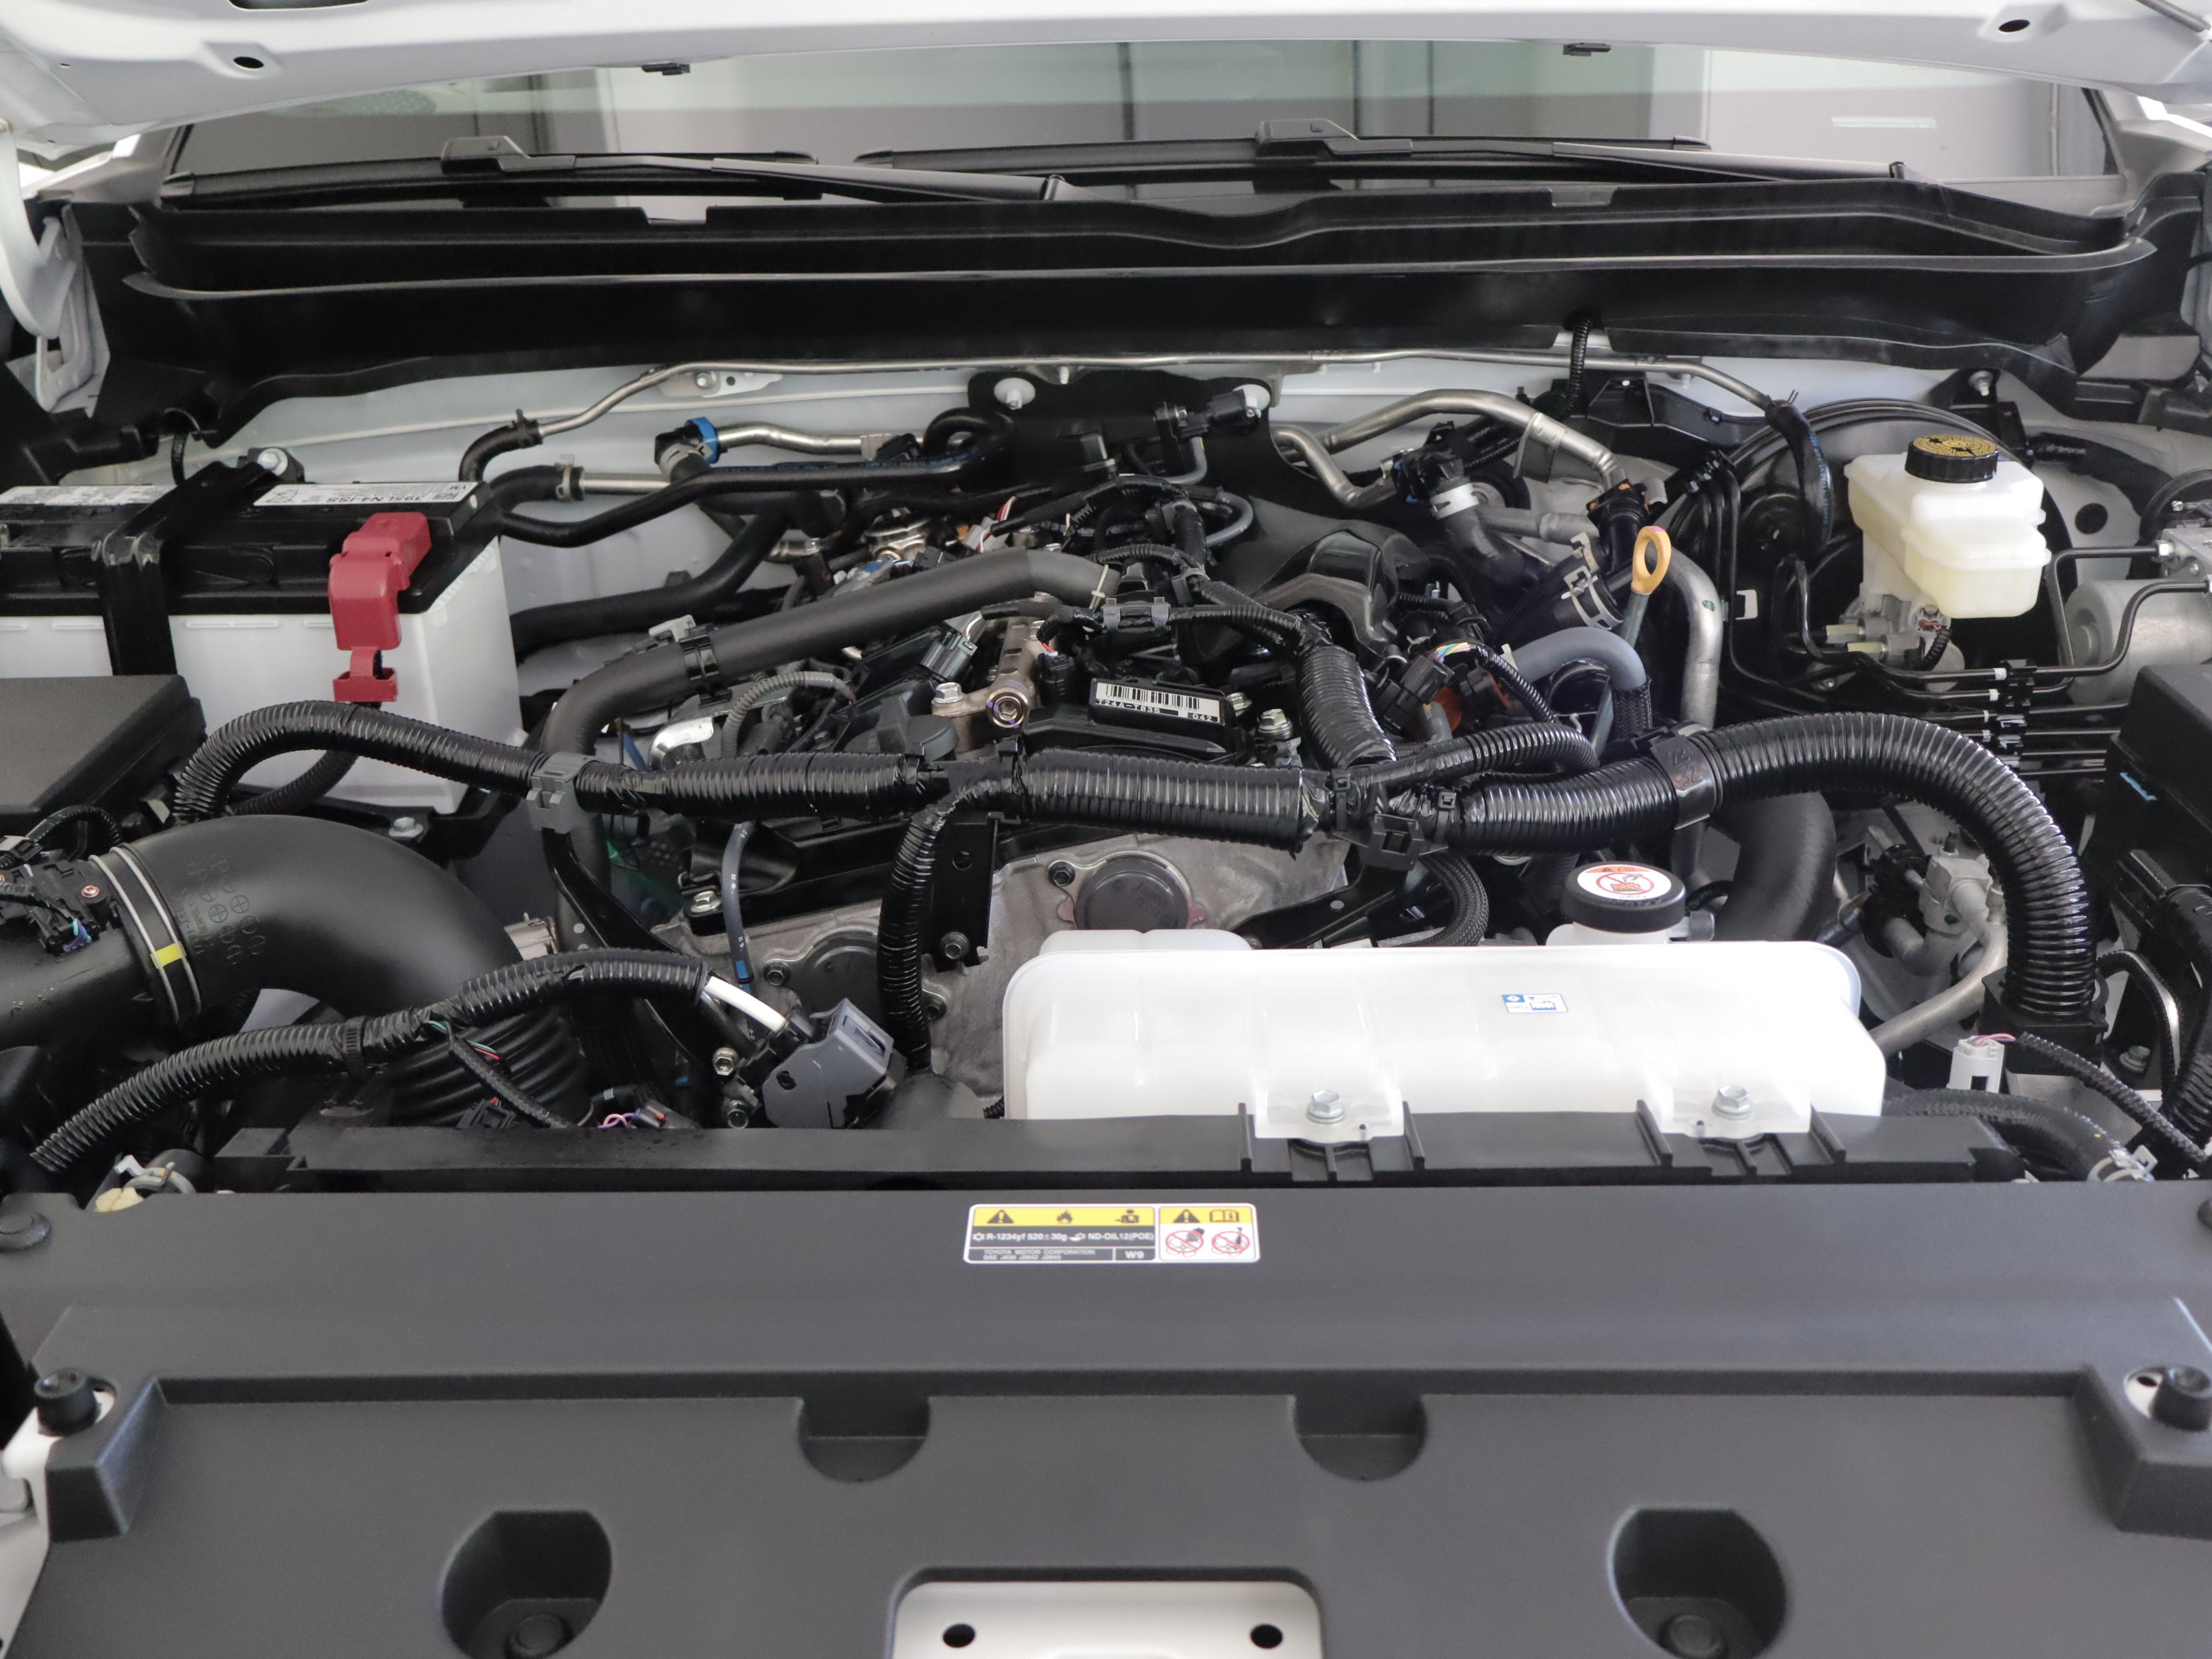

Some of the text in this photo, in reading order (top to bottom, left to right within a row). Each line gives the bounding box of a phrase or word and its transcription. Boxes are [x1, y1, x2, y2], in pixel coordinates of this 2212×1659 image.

[1192, 714, 1212, 722] 042
[986, 1233, 1026, 1241] R-1234yf
[1125, 1250, 1145, 1259] W9
